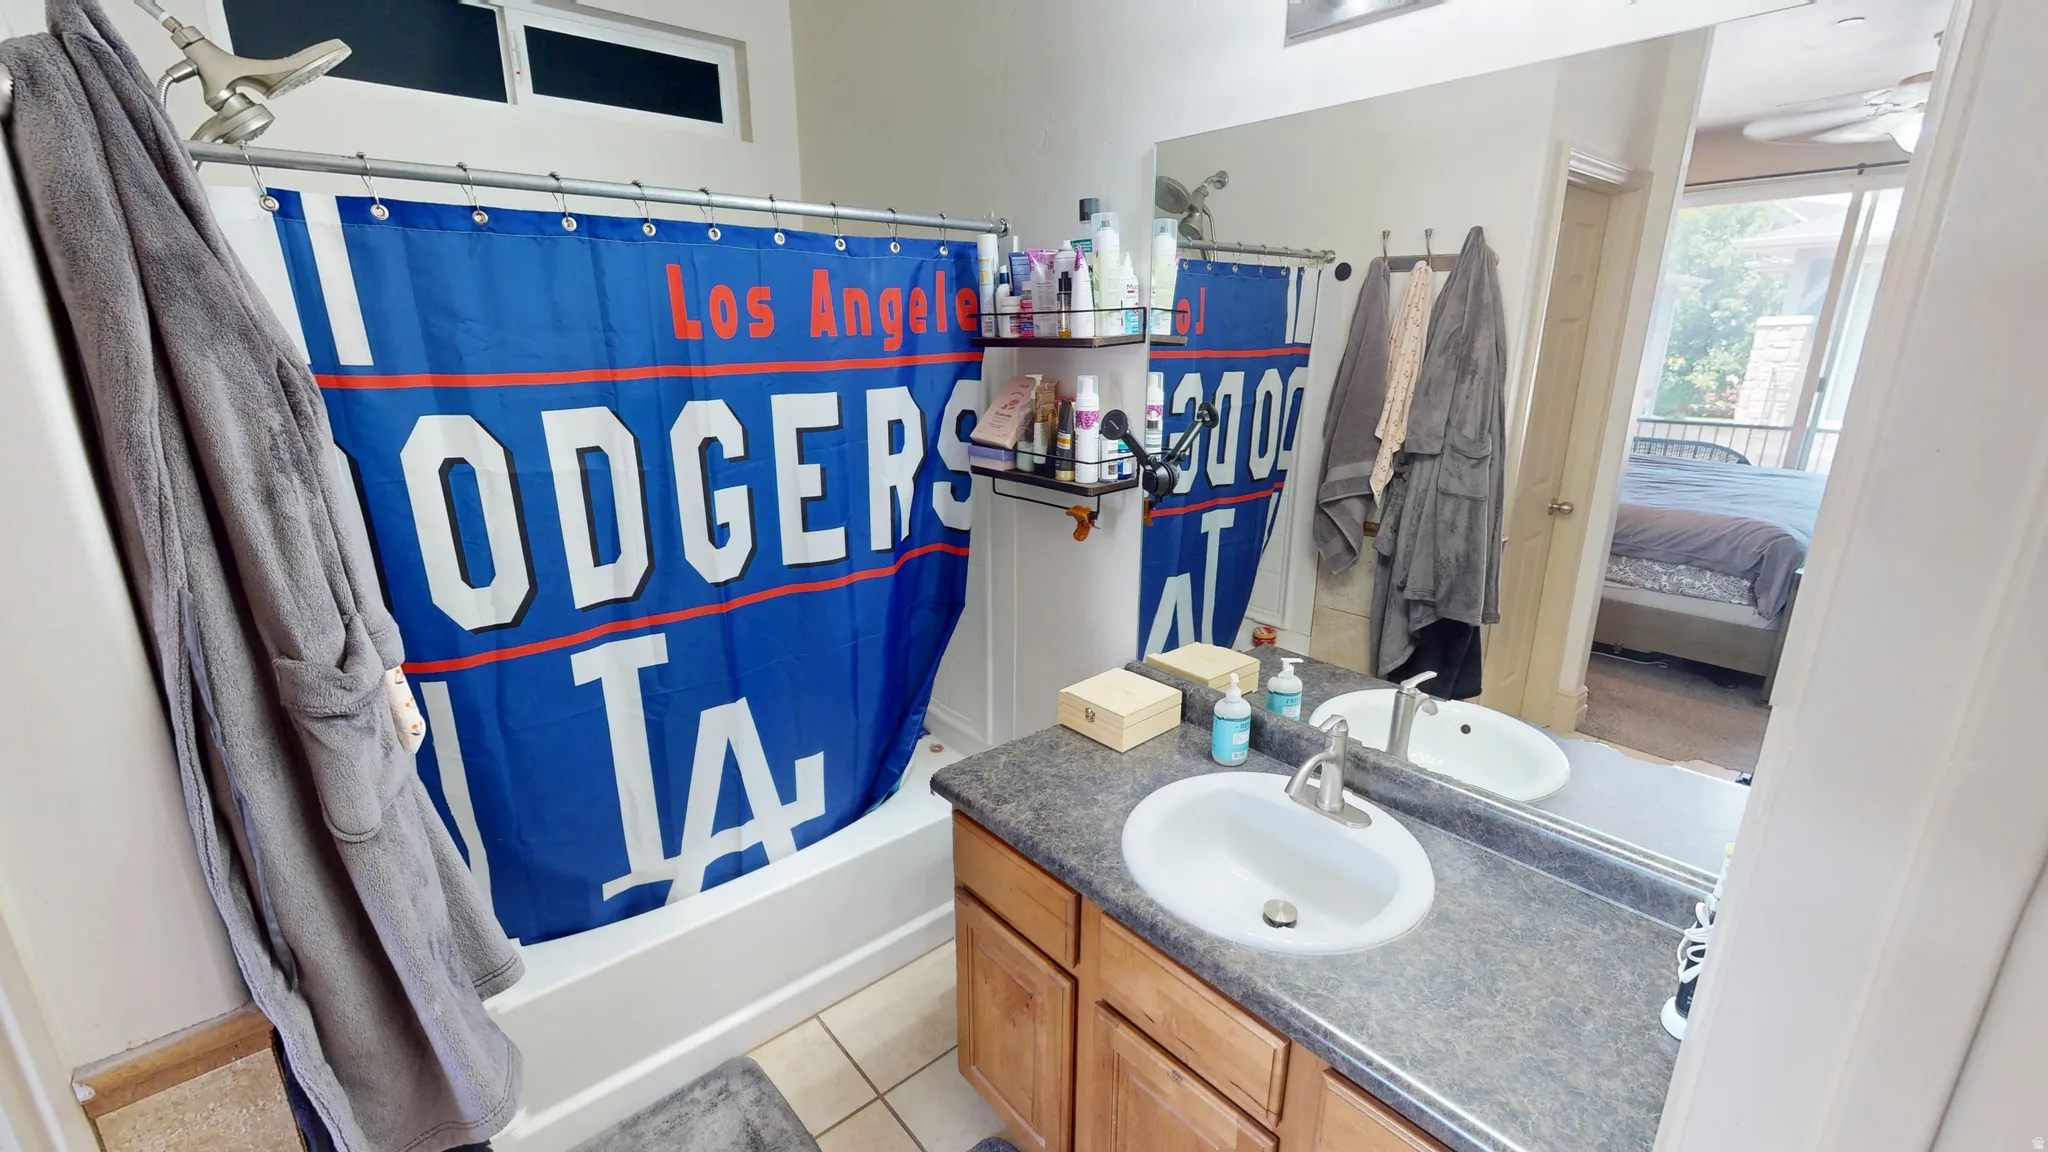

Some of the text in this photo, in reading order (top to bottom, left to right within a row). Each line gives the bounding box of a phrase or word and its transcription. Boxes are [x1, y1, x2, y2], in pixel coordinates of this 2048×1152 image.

[667, 264, 774, 340] Los
[335, 379, 982, 633] ODGERS
[571, 633, 825, 906] LA
